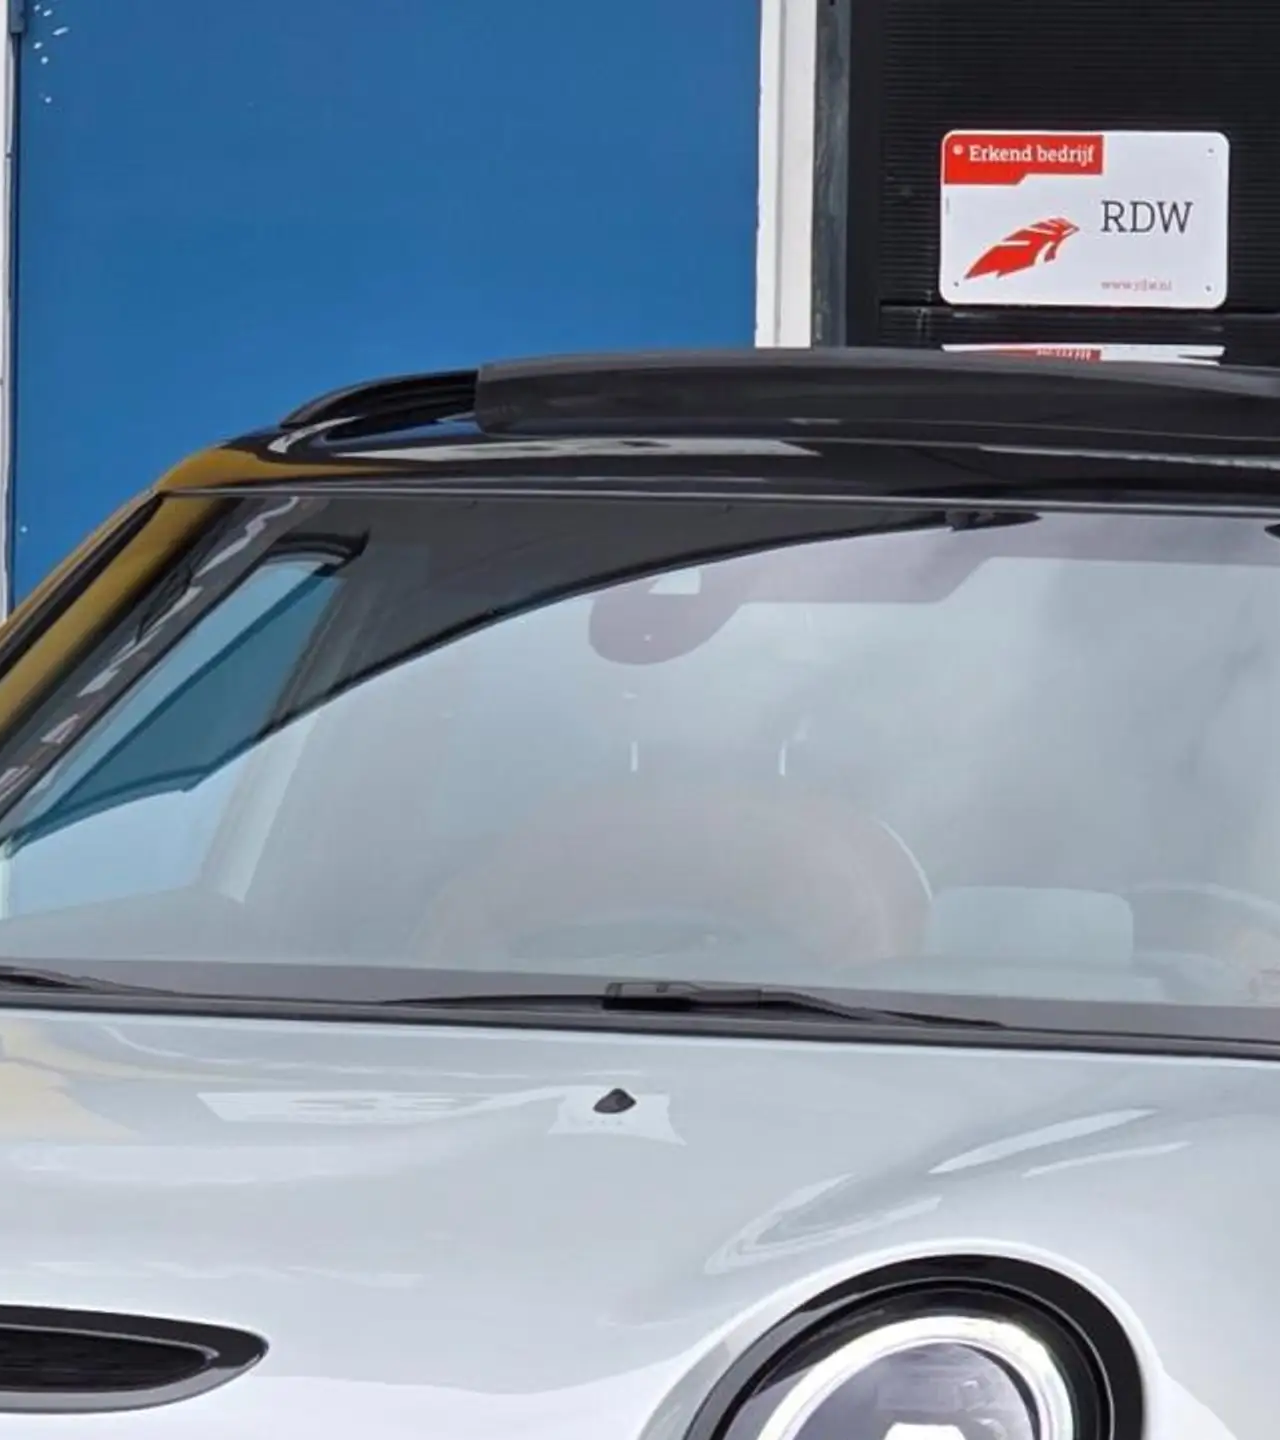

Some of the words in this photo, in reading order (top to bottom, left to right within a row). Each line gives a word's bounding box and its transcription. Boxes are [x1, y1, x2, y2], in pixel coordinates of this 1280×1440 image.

[969, 144, 1032, 163] Erkend
[1037, 144, 1095, 167] bedrijf
[1101, 200, 1193, 233] RDW
